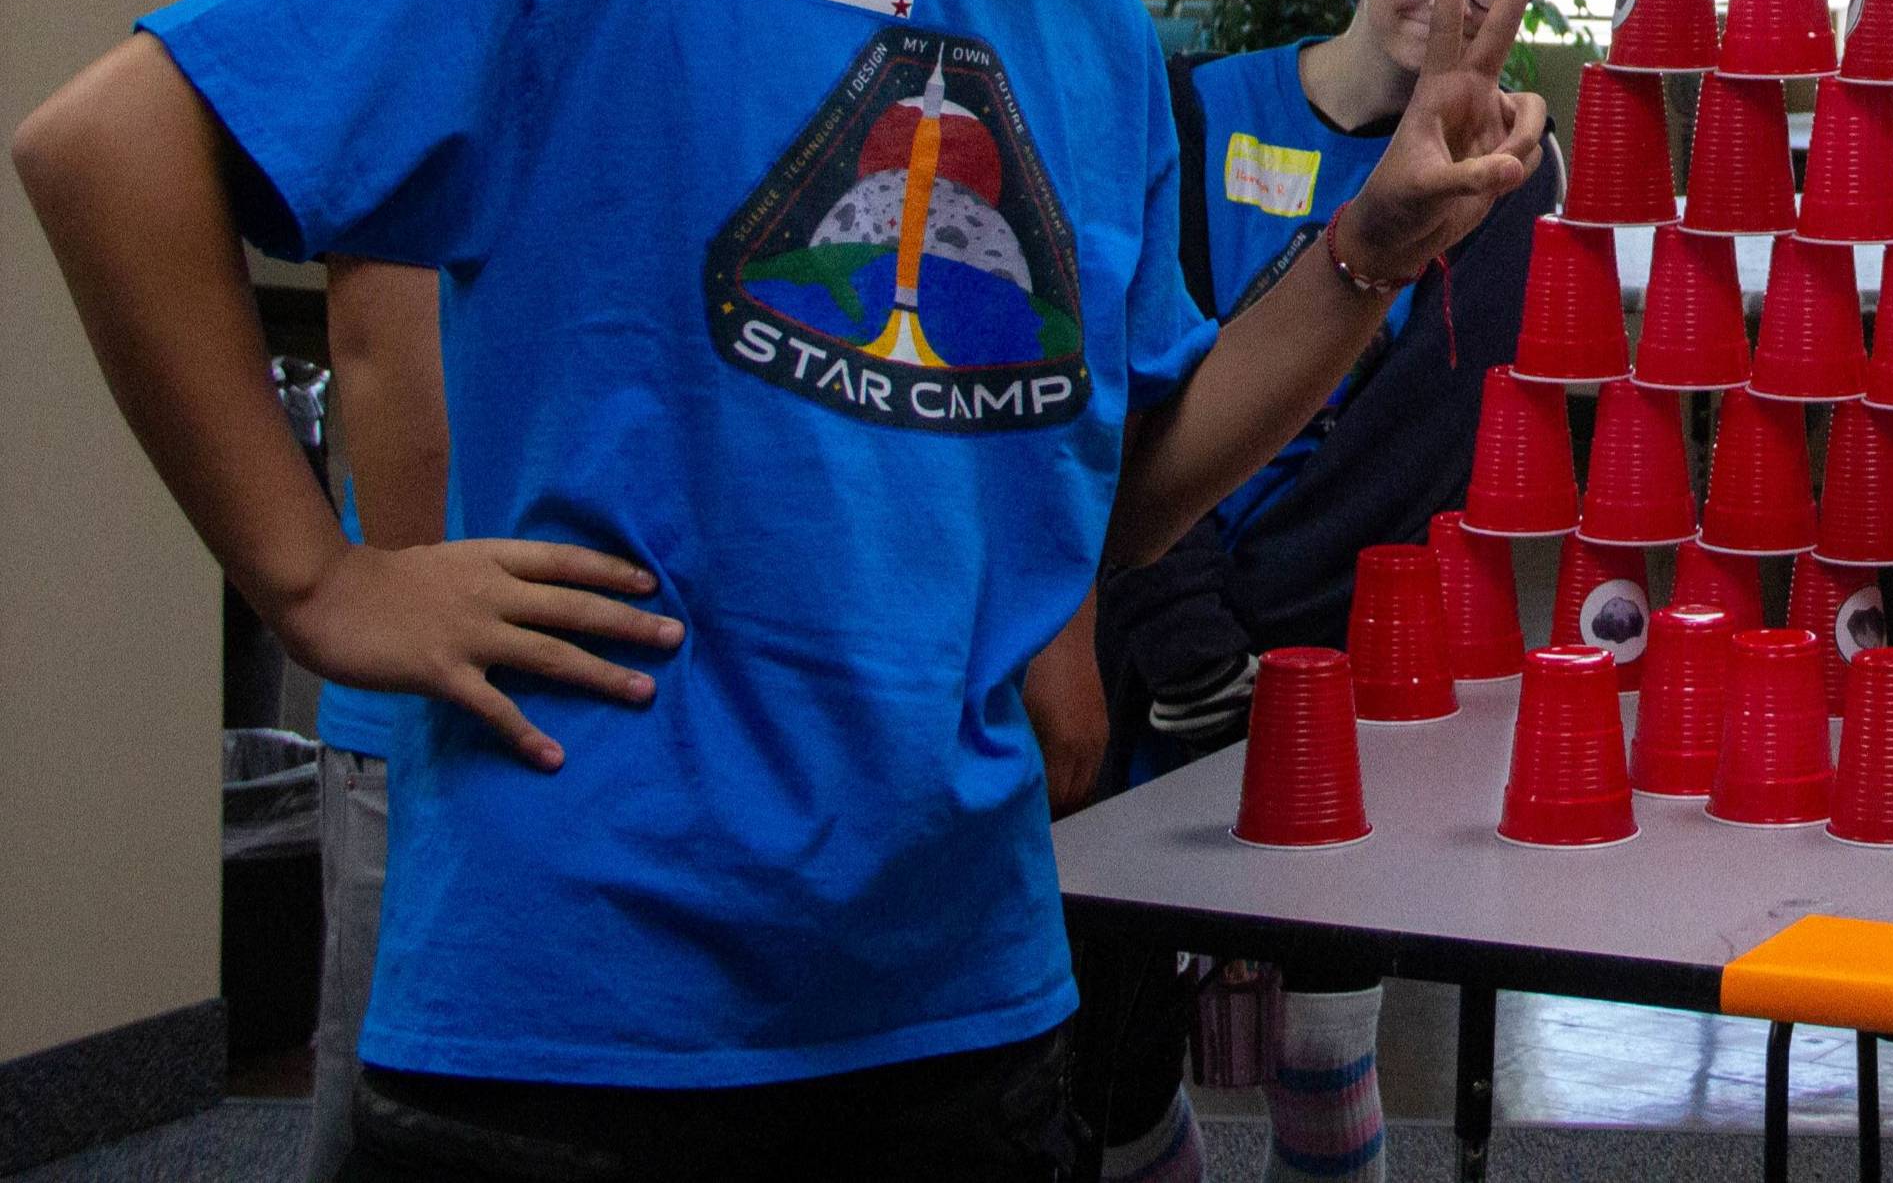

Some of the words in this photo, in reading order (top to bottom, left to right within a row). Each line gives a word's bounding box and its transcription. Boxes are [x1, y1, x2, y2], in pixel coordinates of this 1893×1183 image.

[847, 89, 857, 101] I
[852, 42, 889, 92] DESIGN
[903, 36, 929, 53] MY
[952, 47, 991, 67] OWN
[994, 71, 1025, 134] FUTURE
[734, 188, 781, 242] SCIENCE
[784, 105, 845, 179] TECHNOLOGY
[1277, 232, 1307, 270] DESIGN
[733, 320, 893, 412] STAR
[910, 374, 1072, 419] CAMP
